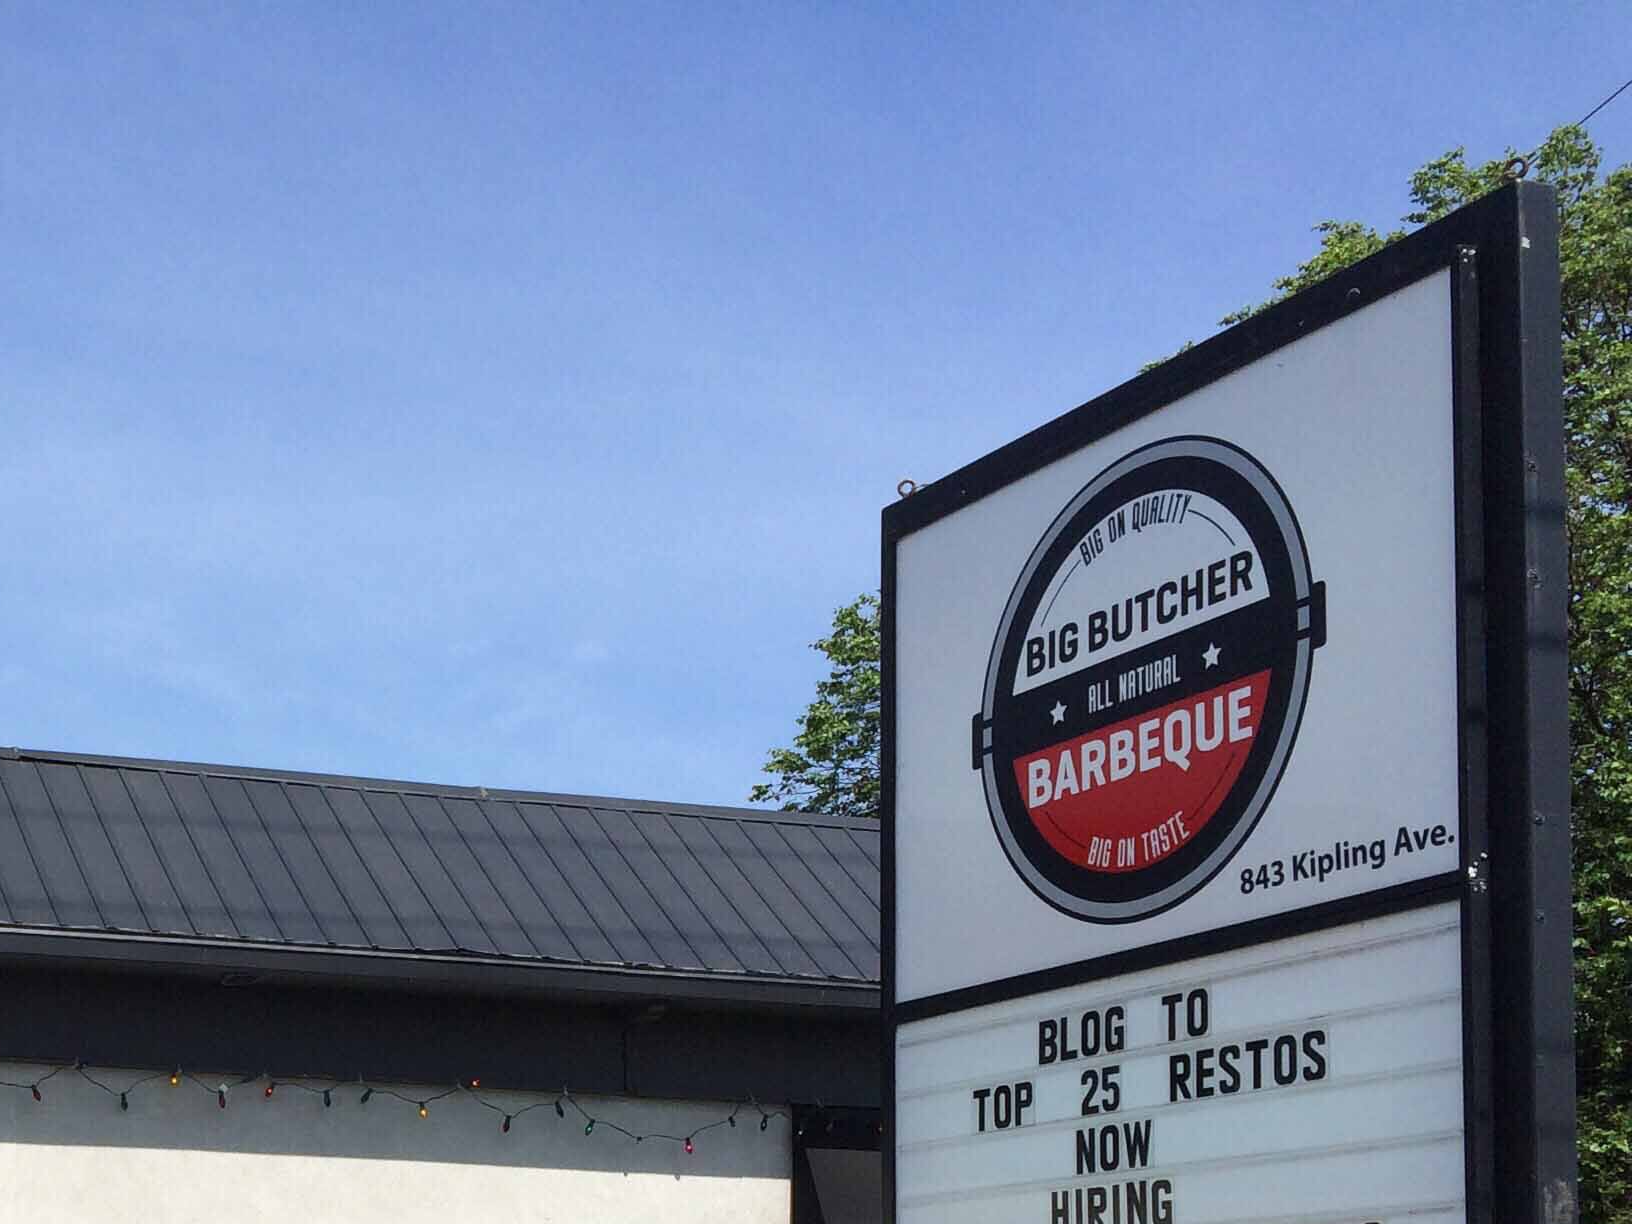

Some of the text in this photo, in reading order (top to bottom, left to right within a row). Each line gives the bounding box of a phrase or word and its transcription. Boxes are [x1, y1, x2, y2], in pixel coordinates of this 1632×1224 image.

[1080, 493, 1192, 567] BIG ON QUALITY
[1026, 550, 1254, 678] BIG BUTCHER
[1088, 654, 1181, 714] ALL NATURAL
[1028, 686, 1253, 810] BARBEQUE
[1087, 810, 1190, 868] BIG ON TASTE
[1240, 824, 1456, 895] 843 Kipling Ave.
[1038, 987, 1209, 1066] BLOG TO
[973, 1029, 1327, 1132] TOP 25 RESTOS
[1075, 1119, 1152, 1175] NOW
